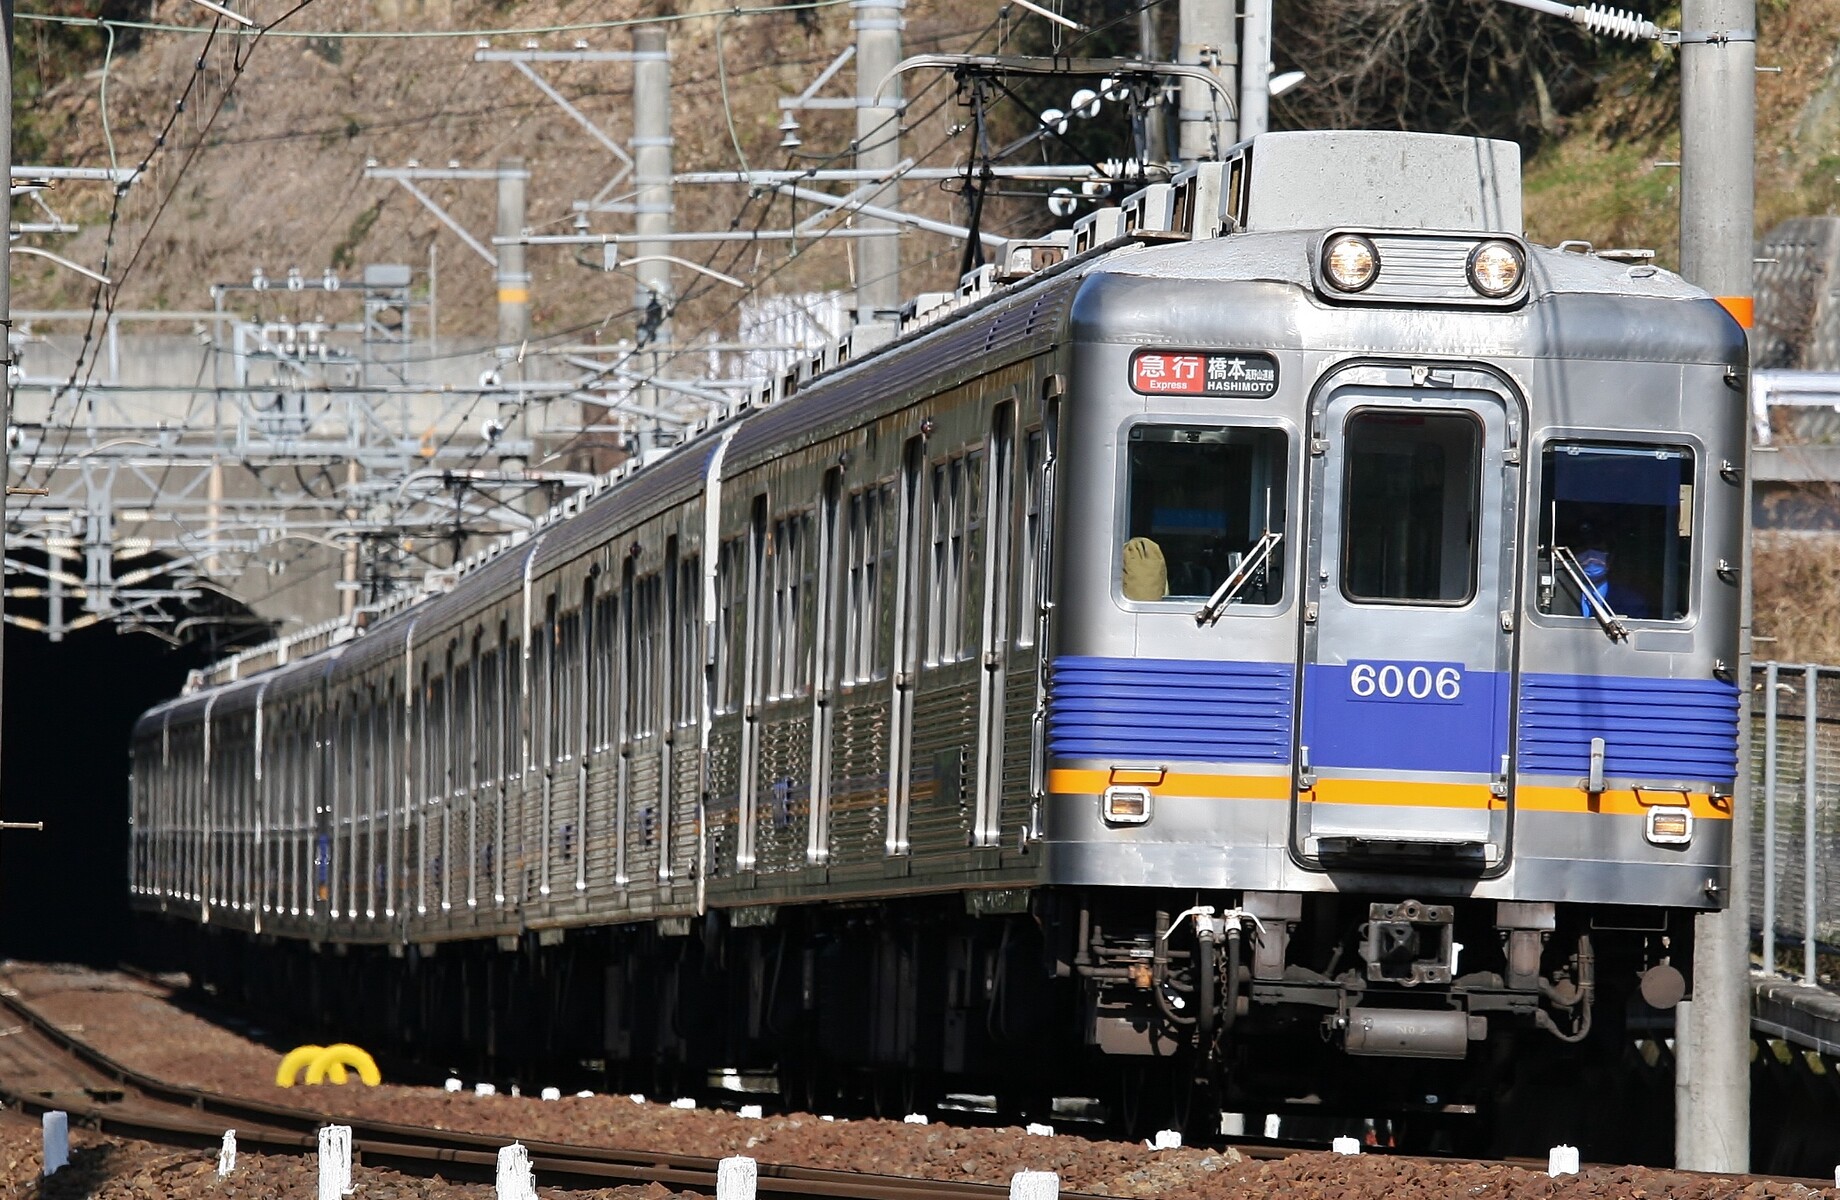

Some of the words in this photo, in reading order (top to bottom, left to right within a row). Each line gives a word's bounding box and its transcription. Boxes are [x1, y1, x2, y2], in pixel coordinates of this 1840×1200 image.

[1139, 355, 1199, 379] 急行
[1208, 356, 1246, 380] 橋本
[1150, 379, 1187, 391] Express
[1207, 382, 1274, 392] HASHIMOTO
[1351, 664, 1461, 700] 6006
